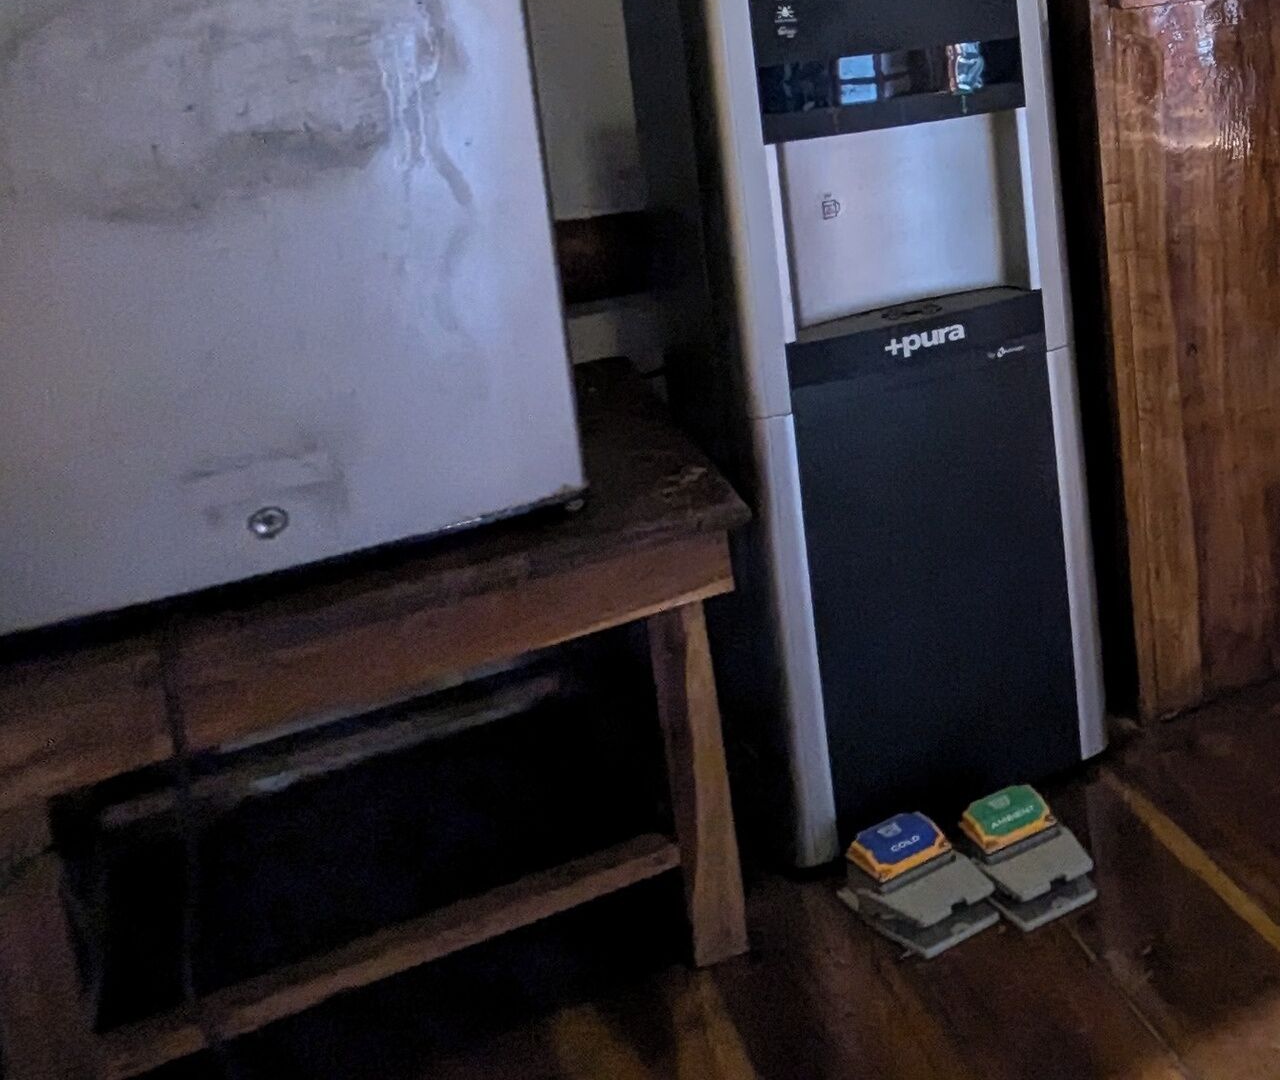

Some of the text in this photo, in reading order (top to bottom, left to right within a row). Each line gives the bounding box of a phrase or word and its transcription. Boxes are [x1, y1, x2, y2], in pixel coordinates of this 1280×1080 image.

[885, 323, 966, 358] +pura
[991, 805, 1035, 830] AMBIENT
[890, 834, 921, 852] COLD
